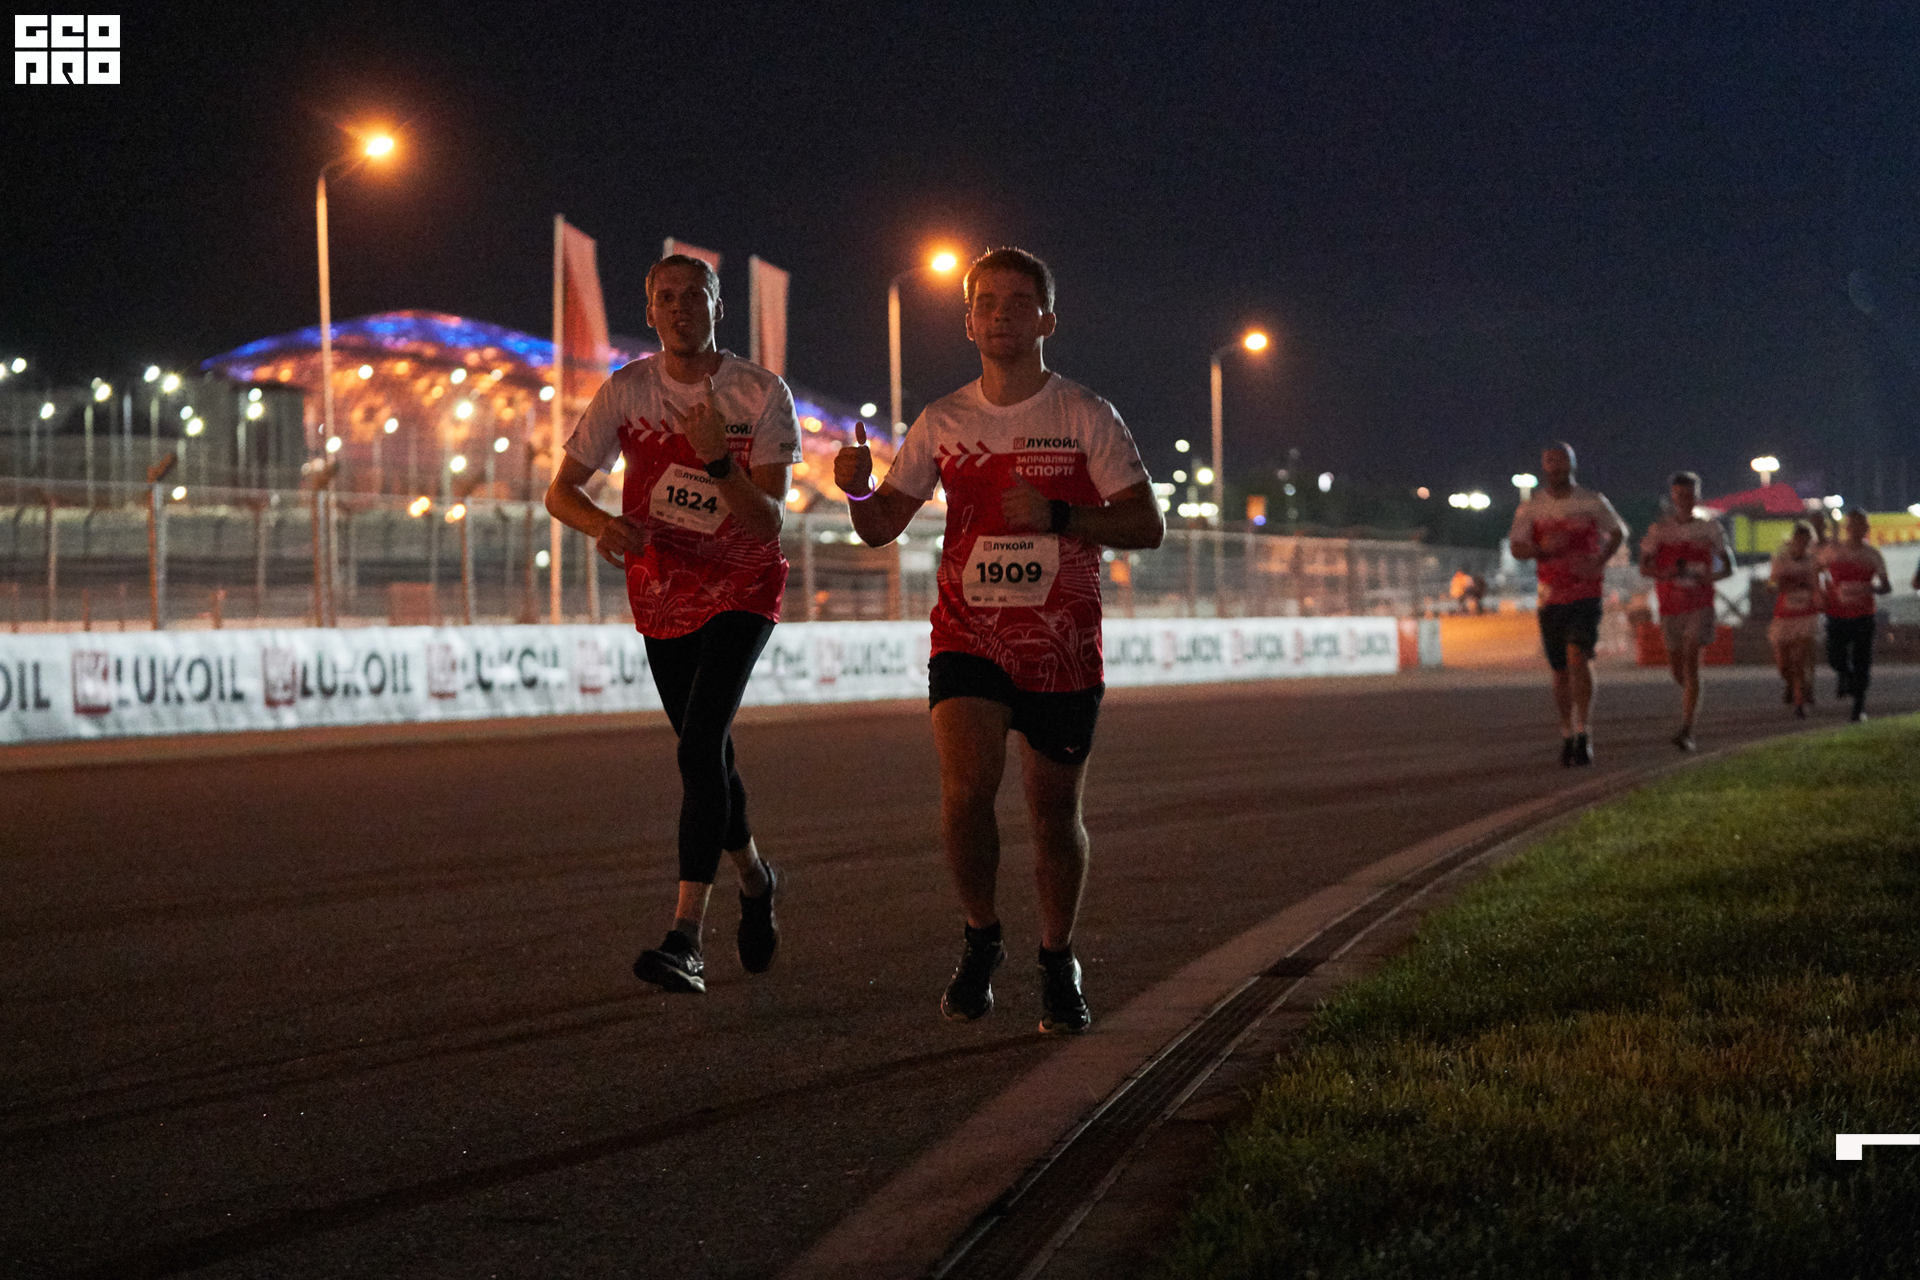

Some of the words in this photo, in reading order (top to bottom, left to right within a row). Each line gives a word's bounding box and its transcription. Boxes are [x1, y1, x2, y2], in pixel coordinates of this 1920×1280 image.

[1026, 437, 1079, 449] ЛУКОЙЛ
[666, 485, 718, 514] 1824
[993, 541, 1034, 550] ЛУКОЙЛ
[976, 561, 1042, 584] 1909
[114, 654, 246, 706] LUKOIL
